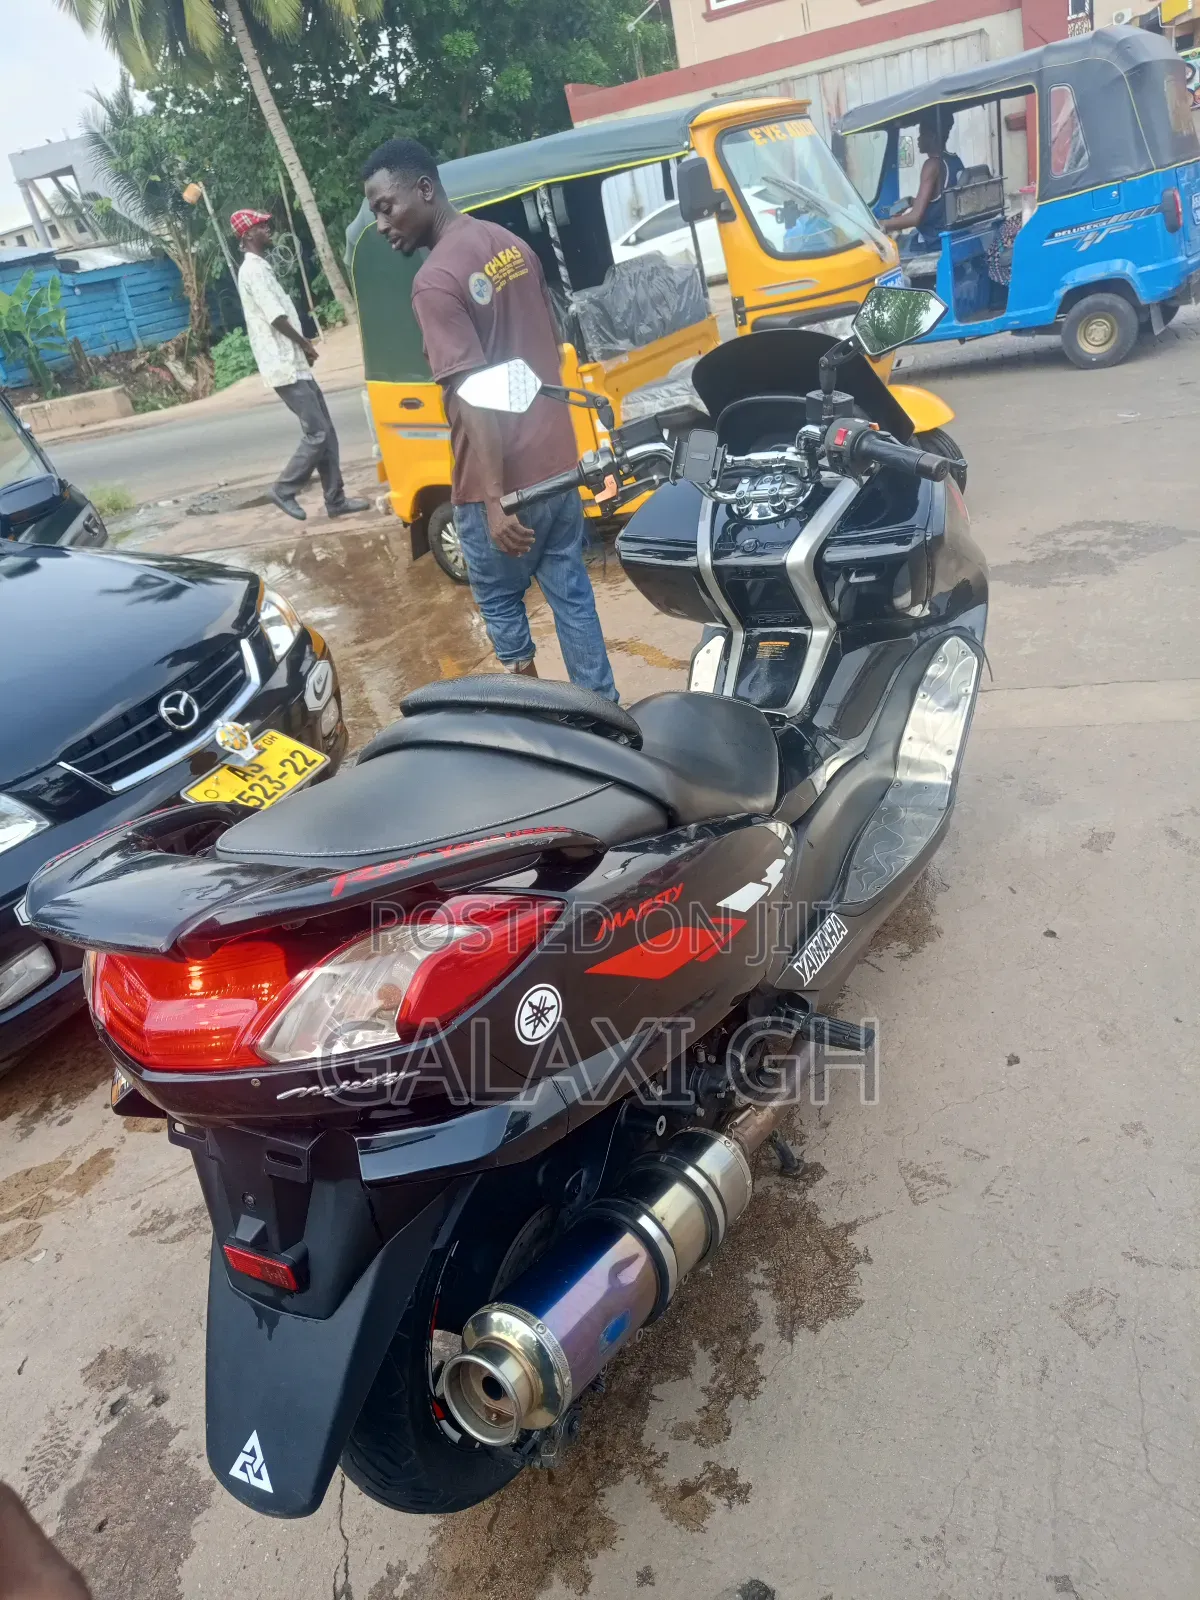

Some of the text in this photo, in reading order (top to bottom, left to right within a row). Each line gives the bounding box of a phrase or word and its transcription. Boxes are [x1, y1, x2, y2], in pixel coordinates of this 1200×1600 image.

[262, 734, 280, 747] GH
[231, 749, 317, 809] 523-22
[594, 882, 685, 942] MAJESTY
[793, 912, 849, 987] YAMAHA
